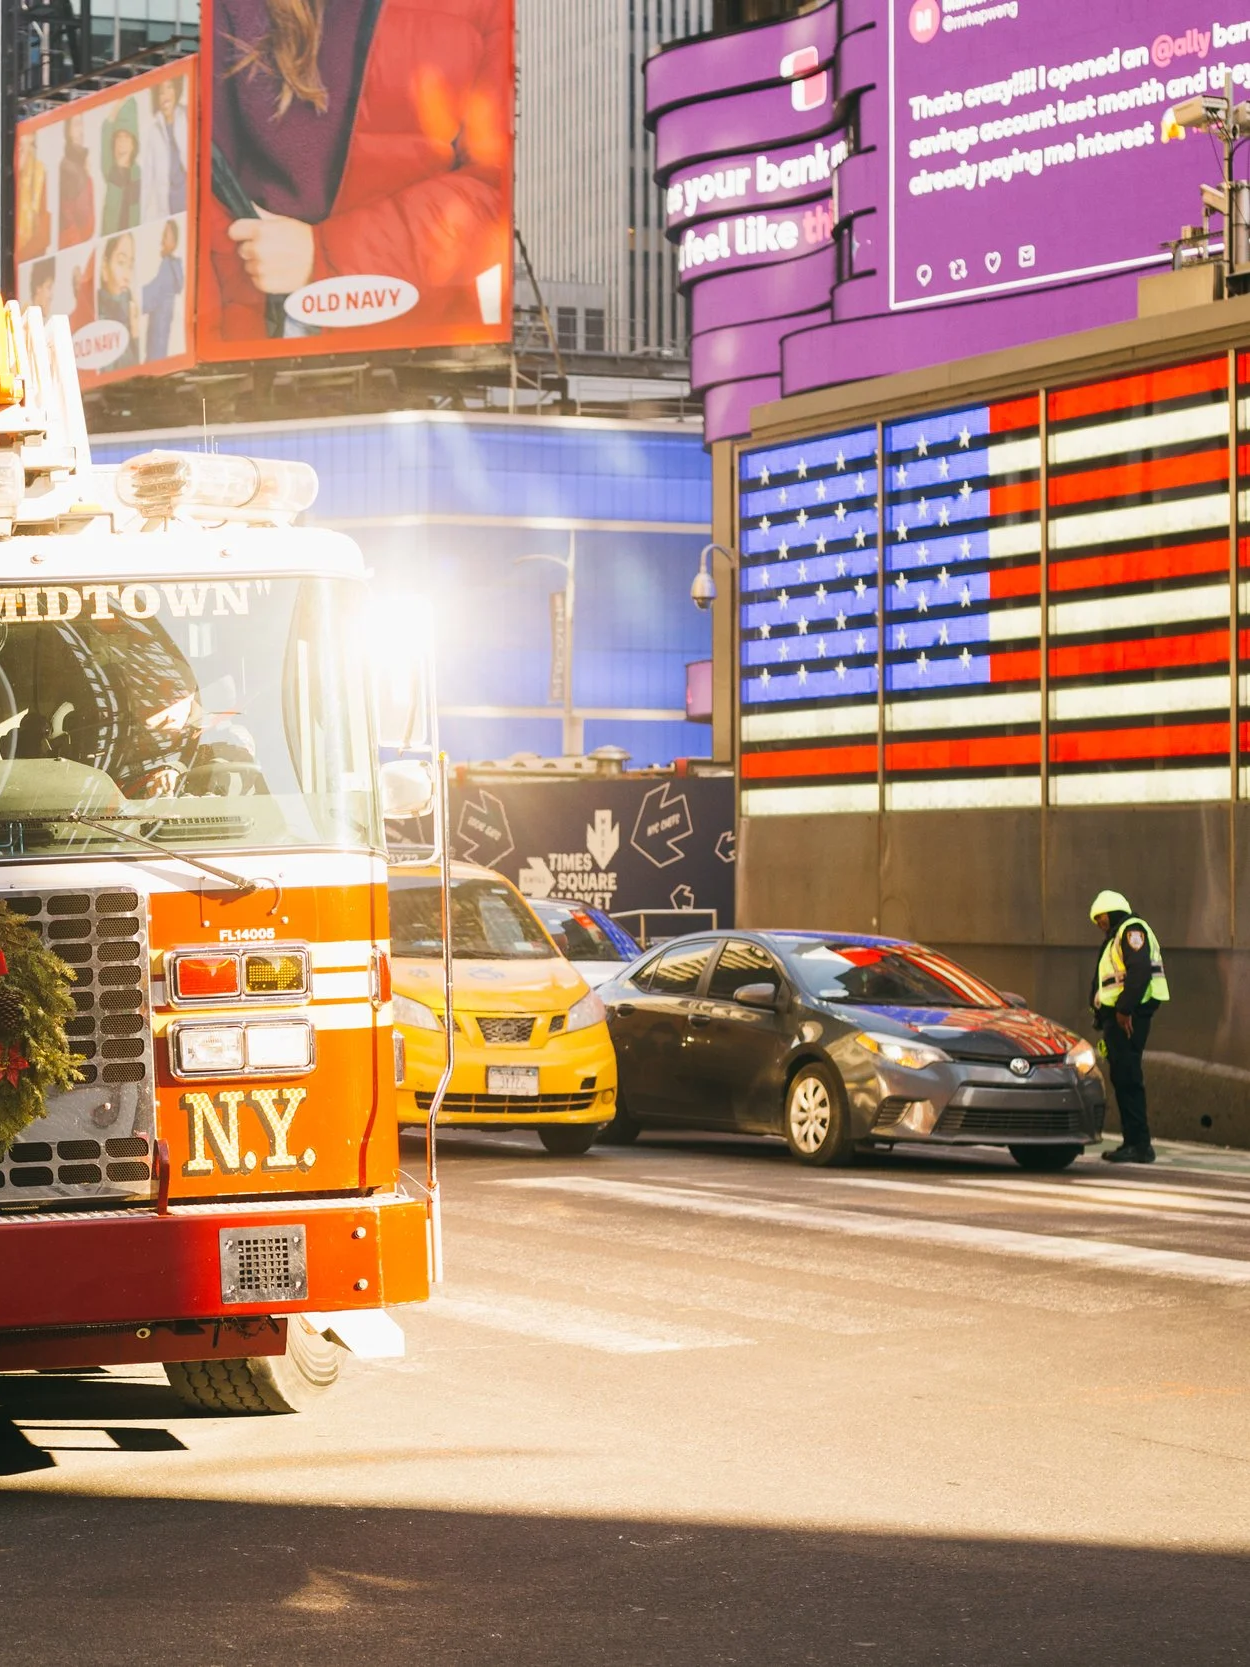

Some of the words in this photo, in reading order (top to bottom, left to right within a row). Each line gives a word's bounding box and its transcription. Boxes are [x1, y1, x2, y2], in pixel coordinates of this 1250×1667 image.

[908, 91, 963, 120] Thats
[963, 67, 1037, 106] crazy!!!!
[1038, 65, 1046, 90] I
[1047, 47, 1120, 92] opened
[1121, 46, 1149, 70] an
[1151, 28, 1211, 68] @ally
[909, 126, 979, 159] savings
[979, 103, 1057, 142] account
[1057, 94, 1097, 124] last
[1097, 78, 1165, 115] month
[1166, 67, 1207, 99] and
[683, 167, 751, 217] your
[756, 142, 830, 193] bank
[909, 160, 978, 196] already
[978, 148, 1043, 187] paying
[1043, 142, 1075, 166] me
[1076, 120, 1155, 159] interest
[685, 222, 730, 268] feel
[734, 215, 799, 255] like
[302, 293, 340, 313] OLD
[346, 288, 401, 310] NAVY
[549, 853, 593, 871] TIMES
[557, 872, 617, 891] SQUARE
[219, 928, 276, 941] FL14005
[185, 1088, 316, 1172] N.Y.
